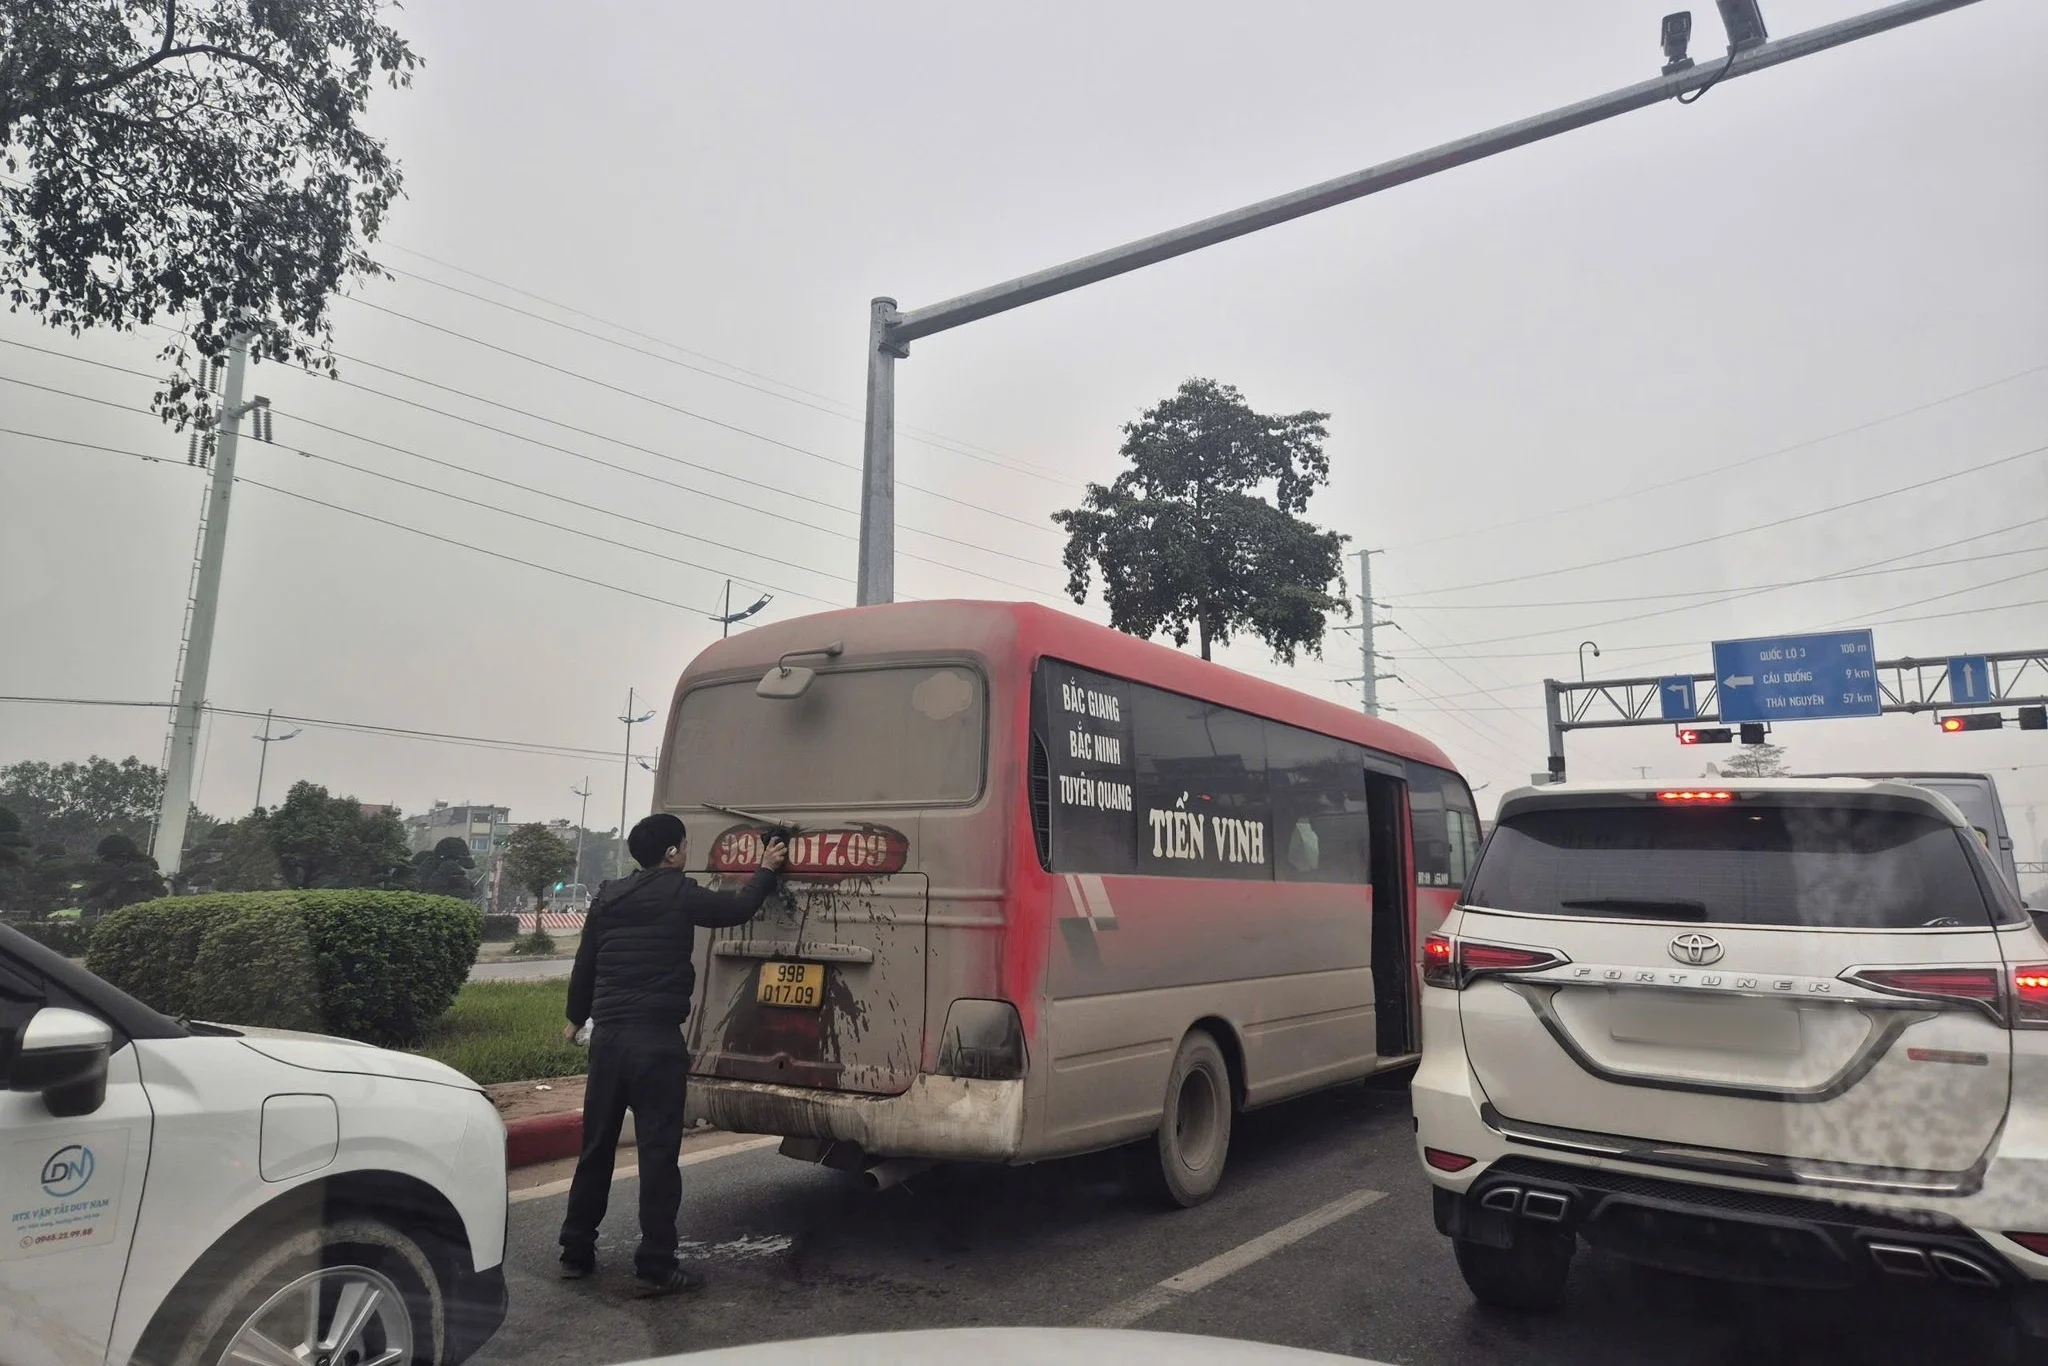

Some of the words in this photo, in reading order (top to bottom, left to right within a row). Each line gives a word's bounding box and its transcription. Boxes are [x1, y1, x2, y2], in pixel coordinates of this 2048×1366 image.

[1760, 647, 1782, 661] QUỐC
[1800, 647, 1806, 658] 3
[1840, 643, 1854, 654] 100
[1857, 644, 1867, 653] m
[1845, 669, 1852, 679] 9
[1855, 668, 1870, 679] km
[1062, 676, 1086, 714] BẮC
[1087, 689, 1120, 723] GIANG
[1765, 695, 1786, 708] THÁI
[1790, 693, 1824, 707] NGUYÊN
[1843, 694, 1854, 704] 57
[1857, 693, 1873, 703] km
[1069, 721, 1092, 761] BẮC
[1094, 734, 1121, 765] NINH
[1059, 771, 1095, 807] TUYÊN
[1096, 780, 1132, 812] QUANG
[1211, 816, 1265, 864] VINH
[788, 832, 888, 867] 017.09
[777, 965, 805, 983] 99B
[1573, 967, 1831, 993] FORTUNER
[763, 986, 814, 1005] 017.09
[70, 1201, 88, 1213] DUY
[89, 1198, 110, 1210] NAM
